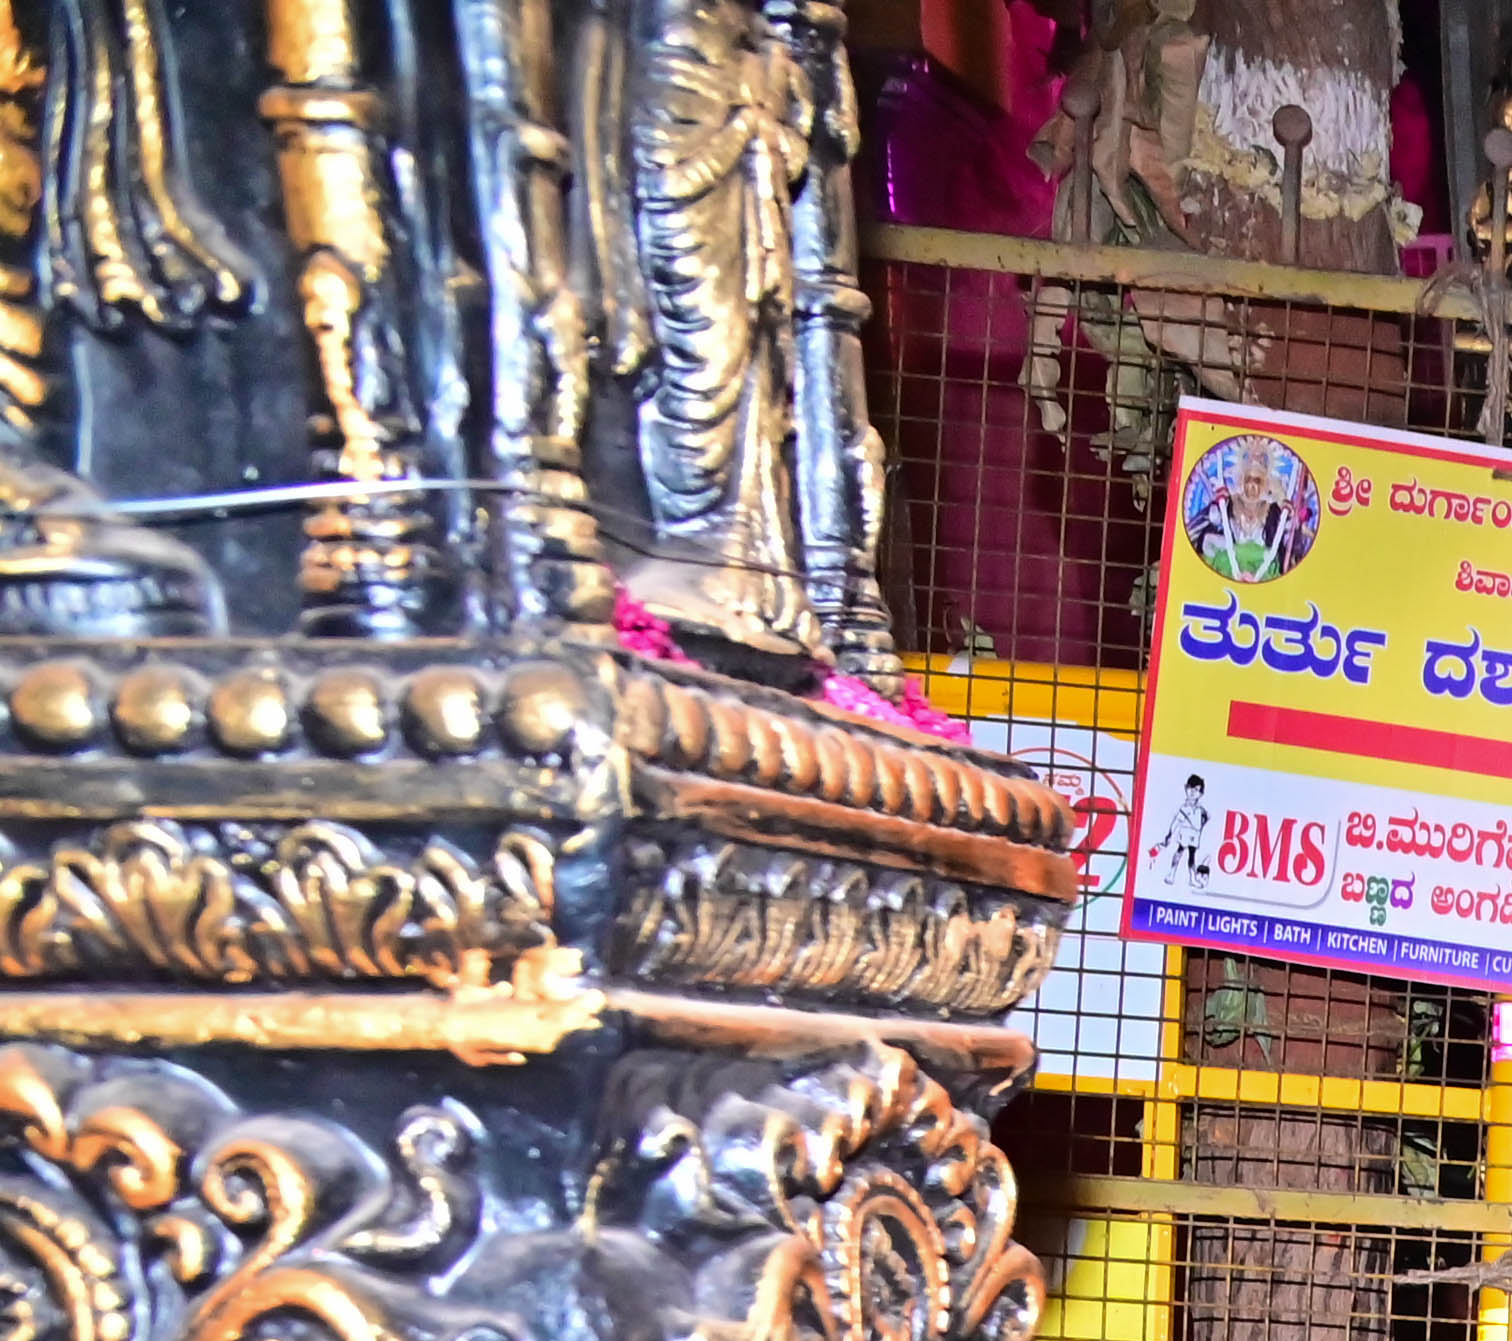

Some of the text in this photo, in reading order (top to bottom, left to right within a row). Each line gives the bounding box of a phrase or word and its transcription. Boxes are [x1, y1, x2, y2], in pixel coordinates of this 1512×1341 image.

[1328, 466, 1372, 516] ಶ್ರೀ
[1178, 587, 1387, 686] ತುರ್ತು
[1217, 810, 1326, 886] BMS
[1341, 871, 1415, 926] ಬಣ್ಣದ
[1156, 906, 1199, 929] PAINT
[1208, 913, 1258, 937] LIGHTS
[1273, 923, 1311, 945] BATH
[1327, 931, 1388, 956] KITCHEN
[1401, 942, 1479, 969] FURNITURE
